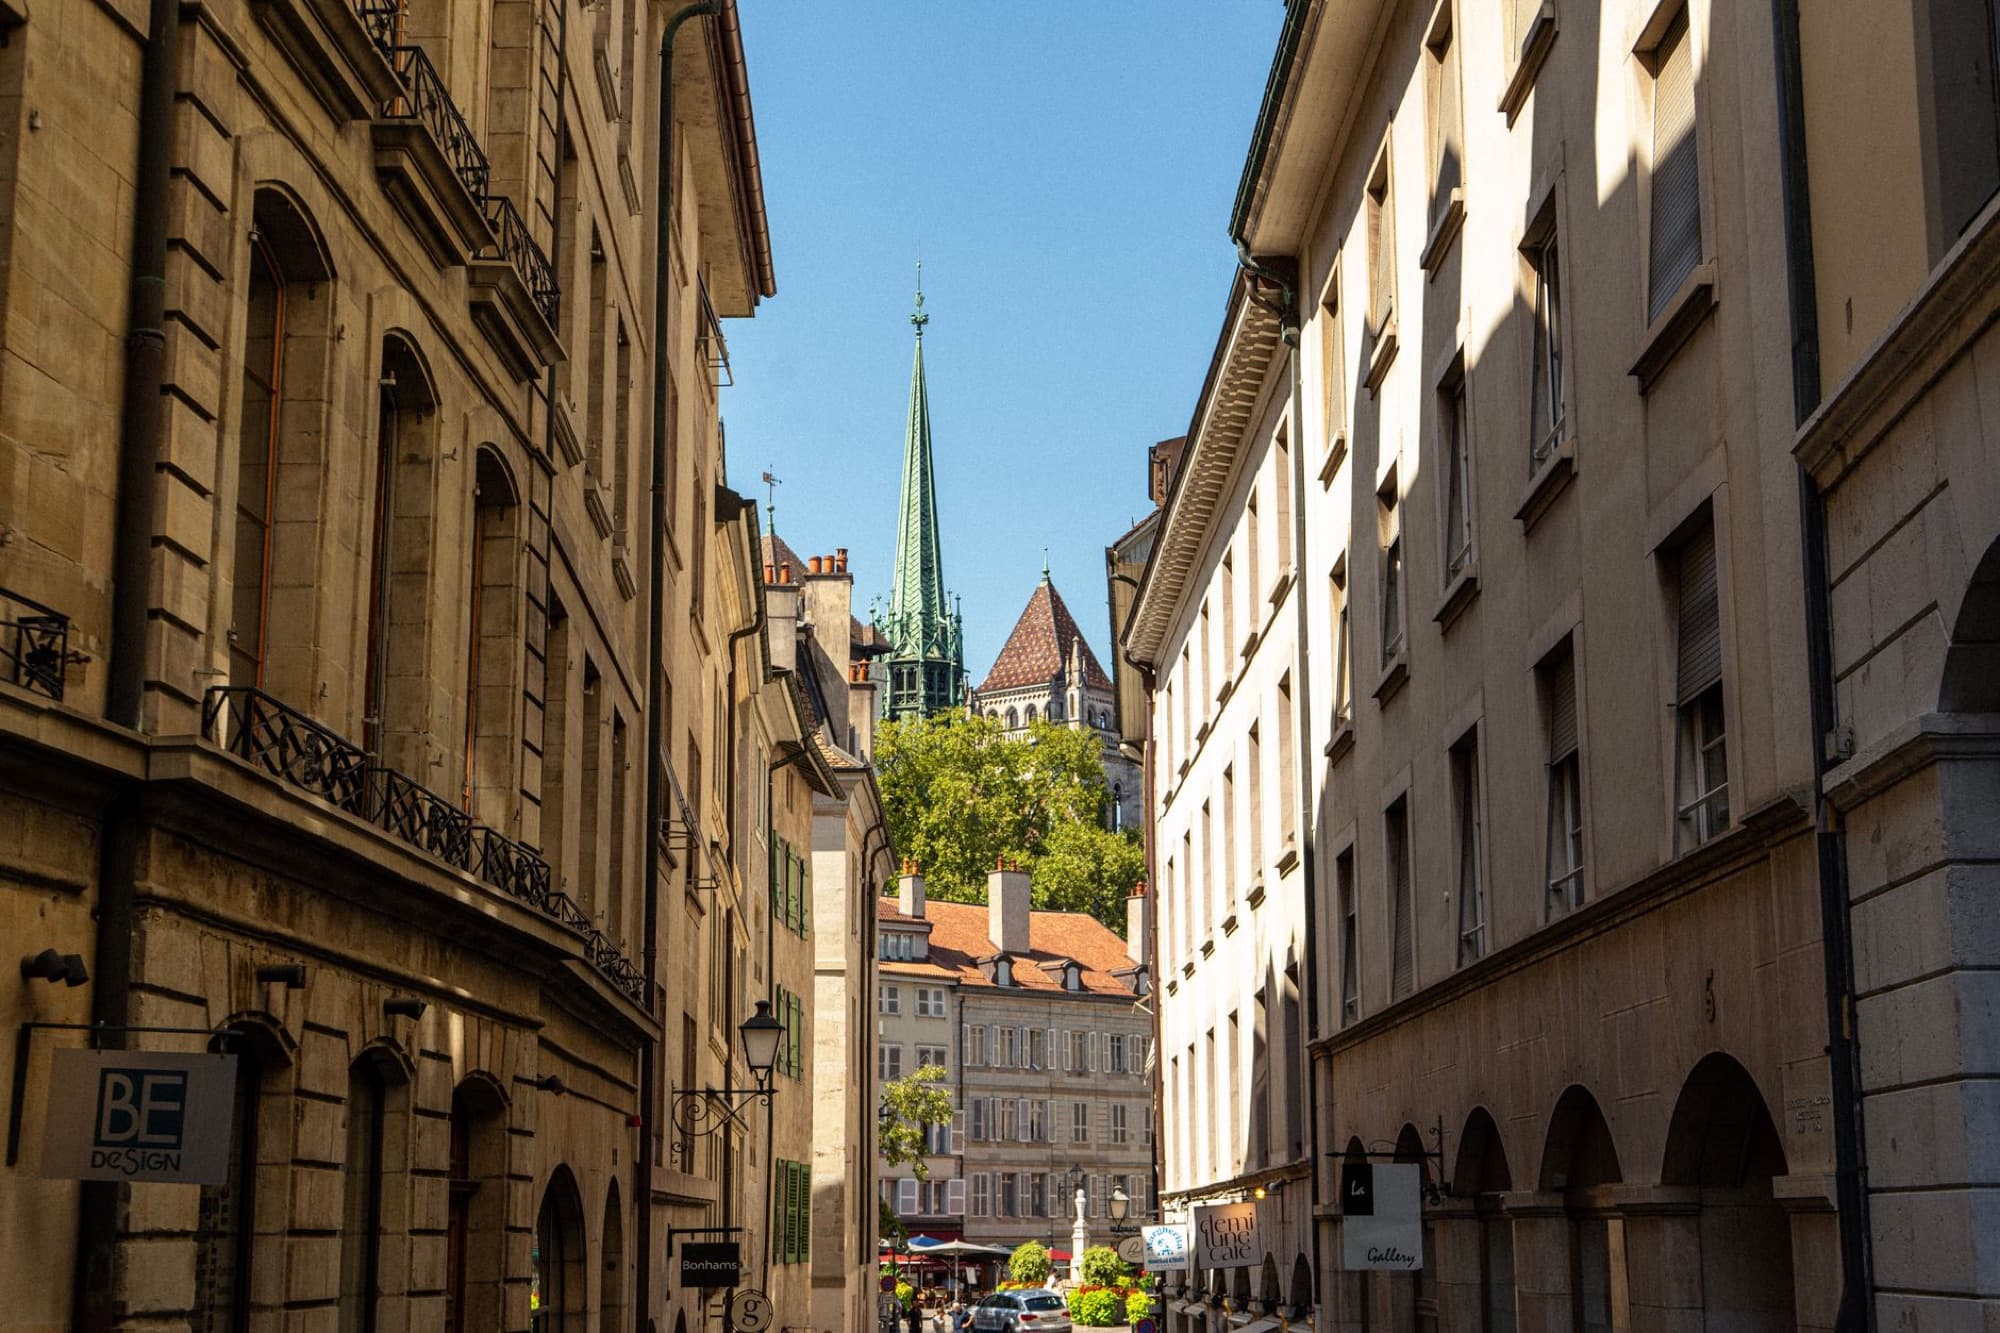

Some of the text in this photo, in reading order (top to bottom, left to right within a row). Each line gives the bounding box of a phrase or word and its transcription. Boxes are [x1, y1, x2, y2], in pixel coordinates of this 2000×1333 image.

[101, 1073, 183, 1144] BE
[1351, 1179, 1366, 1196] La
[1200, 1212, 1254, 1233] demi
[1204, 1229, 1250, 1249] lune
[682, 1260, 738, 1270] Bonhams
[1367, 1247, 1416, 1267] Gallery
[742, 1299, 762, 1327] g
